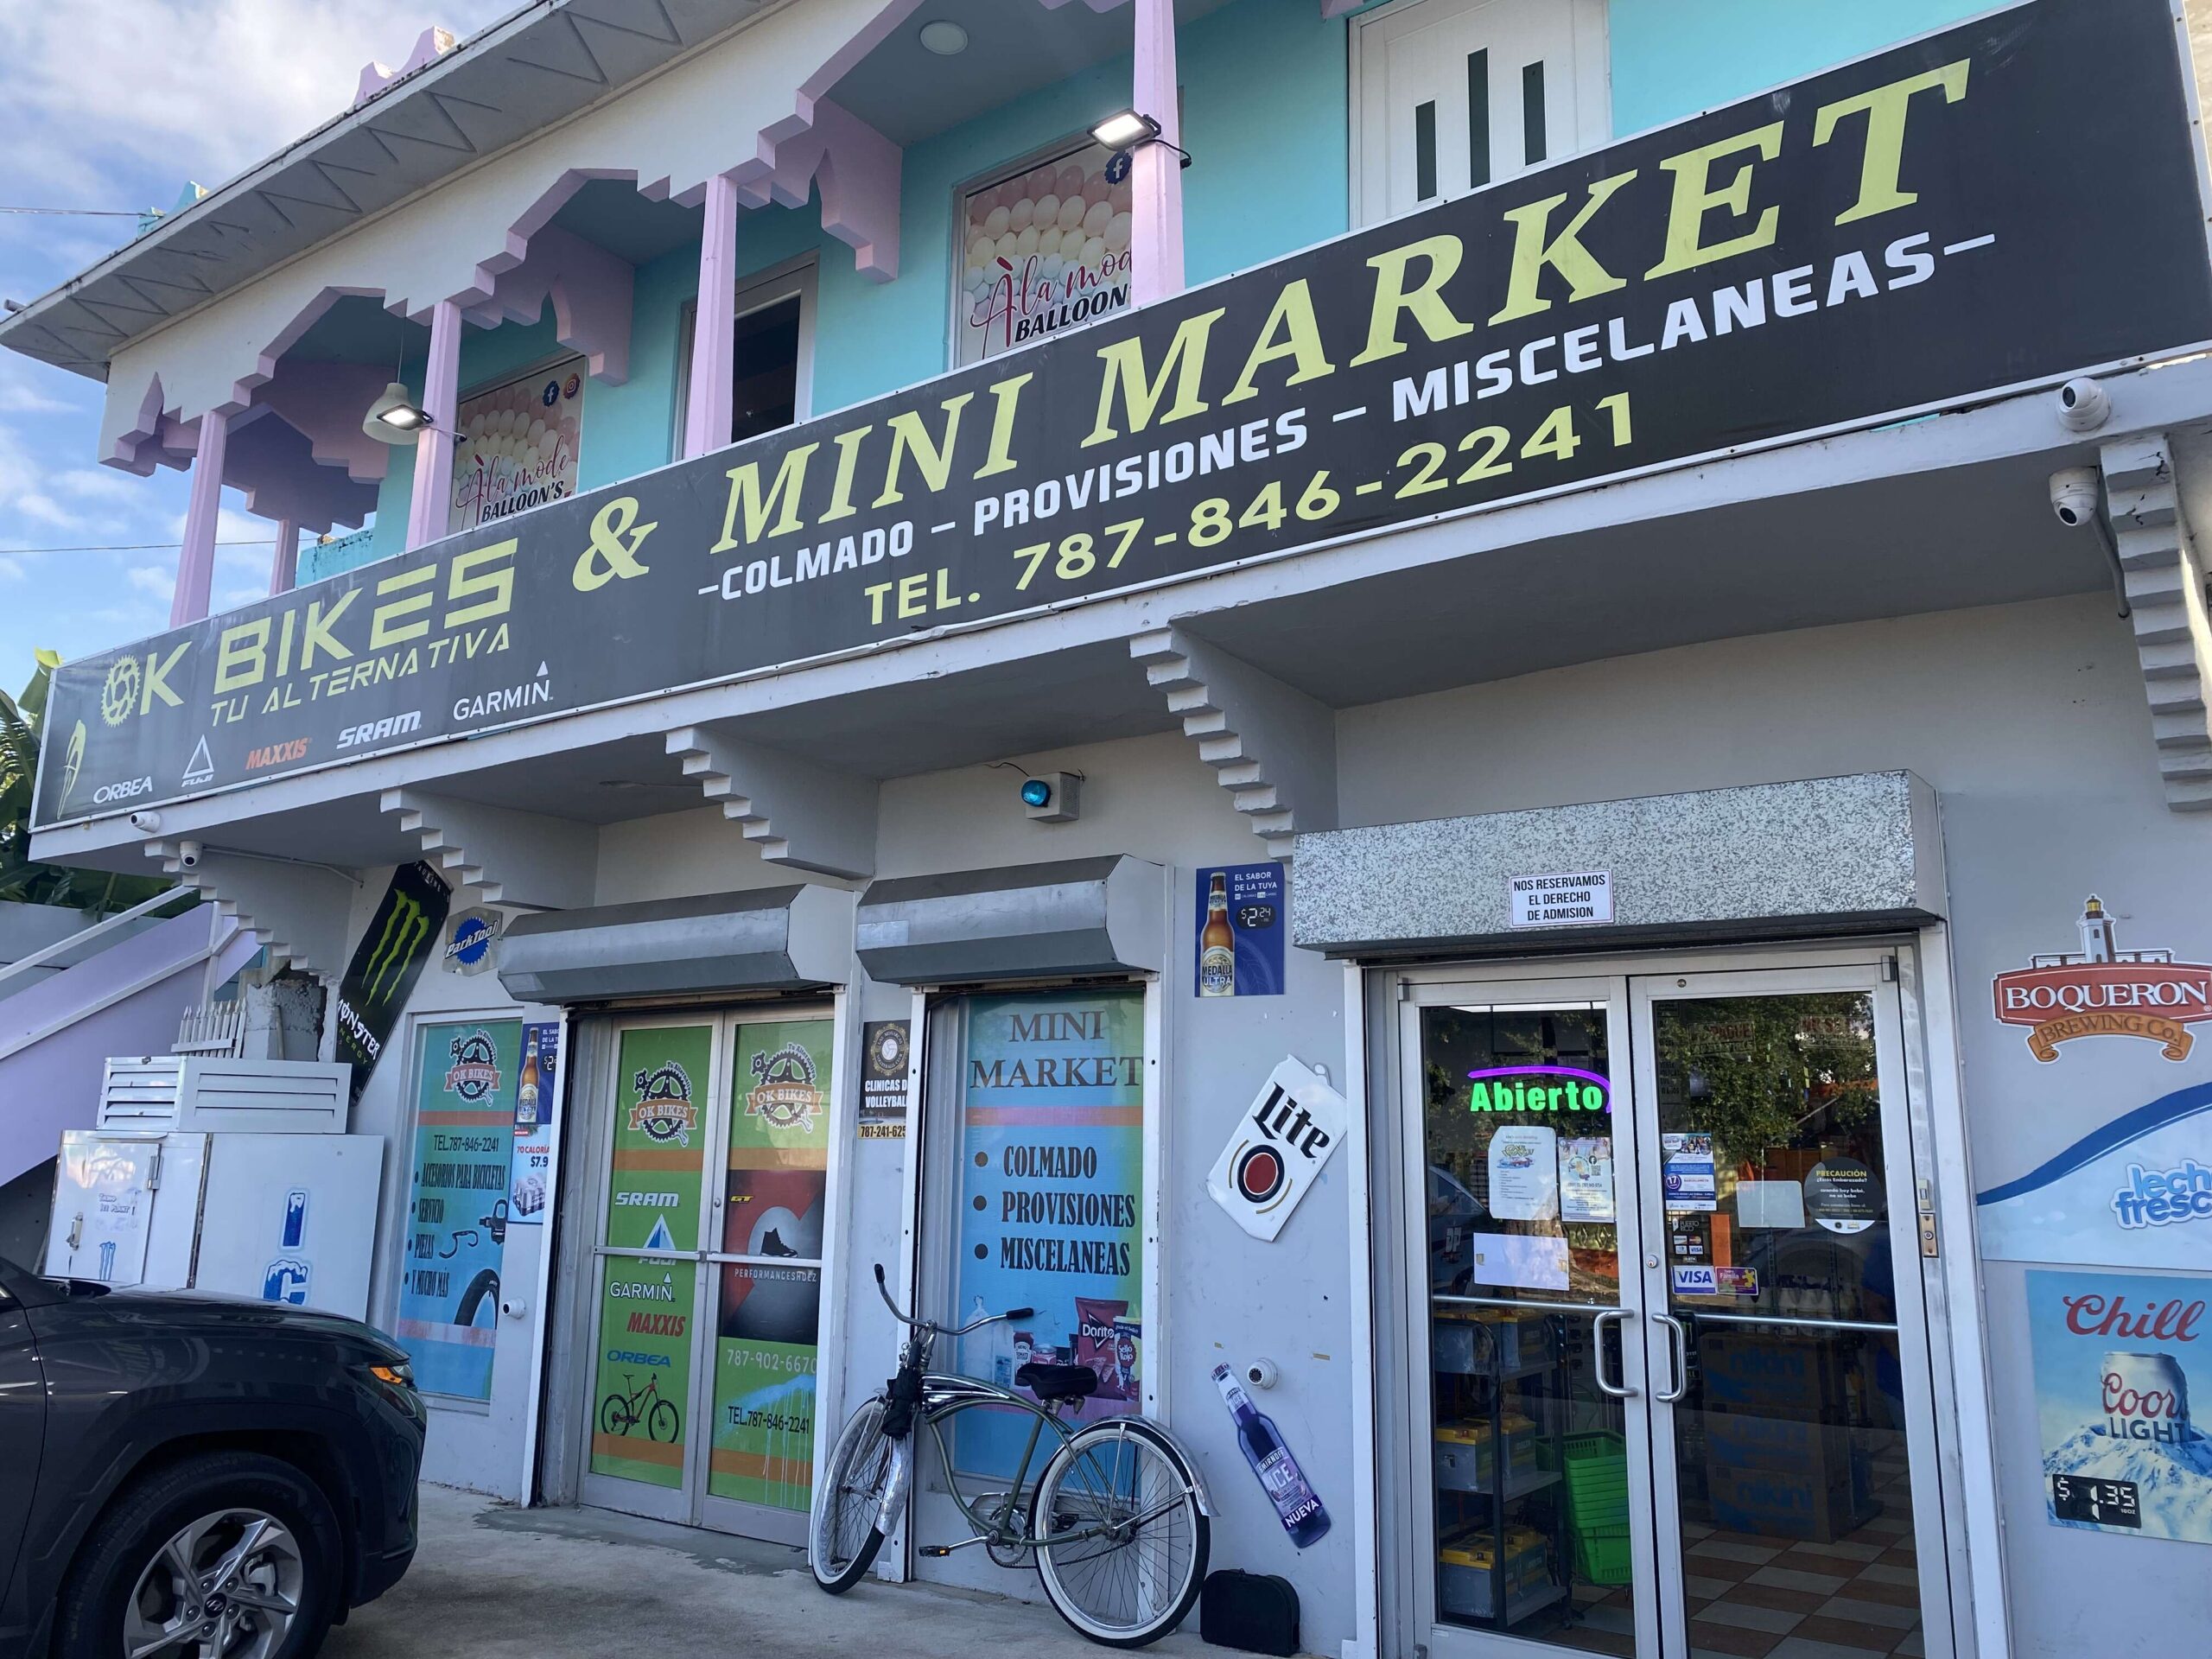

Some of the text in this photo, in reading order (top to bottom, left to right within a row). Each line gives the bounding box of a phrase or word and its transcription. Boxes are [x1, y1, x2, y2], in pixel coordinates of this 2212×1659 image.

[1015, 283, 1132, 343] BALLOON
[101, 58, 1971, 728] OK BIKES & MINI MARKET
[513, 435, 570, 493] mode
[974, 407, 1307, 537] PROVISIONES
[480, 480, 564, 524] BALLOON'S
[865, 391, 1632, 626] TEL. 787-846-2241
[211, 694, 250, 727] TU
[453, 679, 551, 721] GARMIN
[337, 710, 422, 750] SRAM
[245, 741, 308, 771] MAXXIS
[92, 775, 154, 804] ORBEA
[181, 774, 214, 788] FUJI
[1246, 872, 1271, 880] SABOR
[1514, 874, 1605, 891] NOS RESERVAMOS
[1529, 891, 1591, 906] EL DERECHO
[1528, 906, 1593, 921] DE ADMISION
[1202, 965, 1233, 976] MEDALLA
[1203, 976, 1231, 986] ULTRA
[2005, 981, 2208, 1013] BOQUERON
[1008, 1010, 1105, 1043] MINI
[2042, 1014, 2141, 1043] BREWING
[340, 1027, 368, 1065] NERGY
[454, 1068, 493, 1081] OK BIKES
[865, 1079, 907, 1092] CLINICAS D
[970, 1056, 1144, 1089] MARKET
[757, 1089, 812, 1103] OK BIKES
[865, 1096, 907, 1108] VOLLEYBAL
[1470, 1081, 1603, 1113] Abierto
[639, 1104, 689, 1119] OK BIKES
[1252, 1081, 1331, 1160] Lite
[530, 1155, 549, 1167] $7.9
[1003, 1146, 1097, 1179] COLMADO
[1815, 1168, 1867, 1177] PRECAUCIÓN
[455, 1164, 471, 1189] PARA
[473, 1165, 506, 1190] BICICLETAS
[1669, 1175, 1676, 1184] 17
[2132, 1162, 2212, 1198] lech
[418, 1198, 444, 1224] SERVICIO
[615, 1192, 679, 1207] SRAM
[730, 1194, 754, 1203] GT
[1001, 1191, 1135, 1228] PROVISIONES
[414, 1233, 435, 1259] PIEZAS
[1001, 1236, 1130, 1276] MISCELANEAS
[410, 1267, 449, 1297] Y MUCHO MÁS
[610, 1281, 673, 1301] GARMIN
[1679, 1271, 1713, 1284] VISA
[626, 1312, 686, 1337] MAXXIS
[1083, 1324, 1115, 1338] Dorito
[2063, 1294, 2205, 1342] Chill
[607, 1350, 671, 1368] ORBEA
[2110, 1417, 2185, 1445] LIGHT
[1259, 1450, 1285, 1472] SMIRNOFF
[1285, 1499, 1319, 1528] NUEVA
